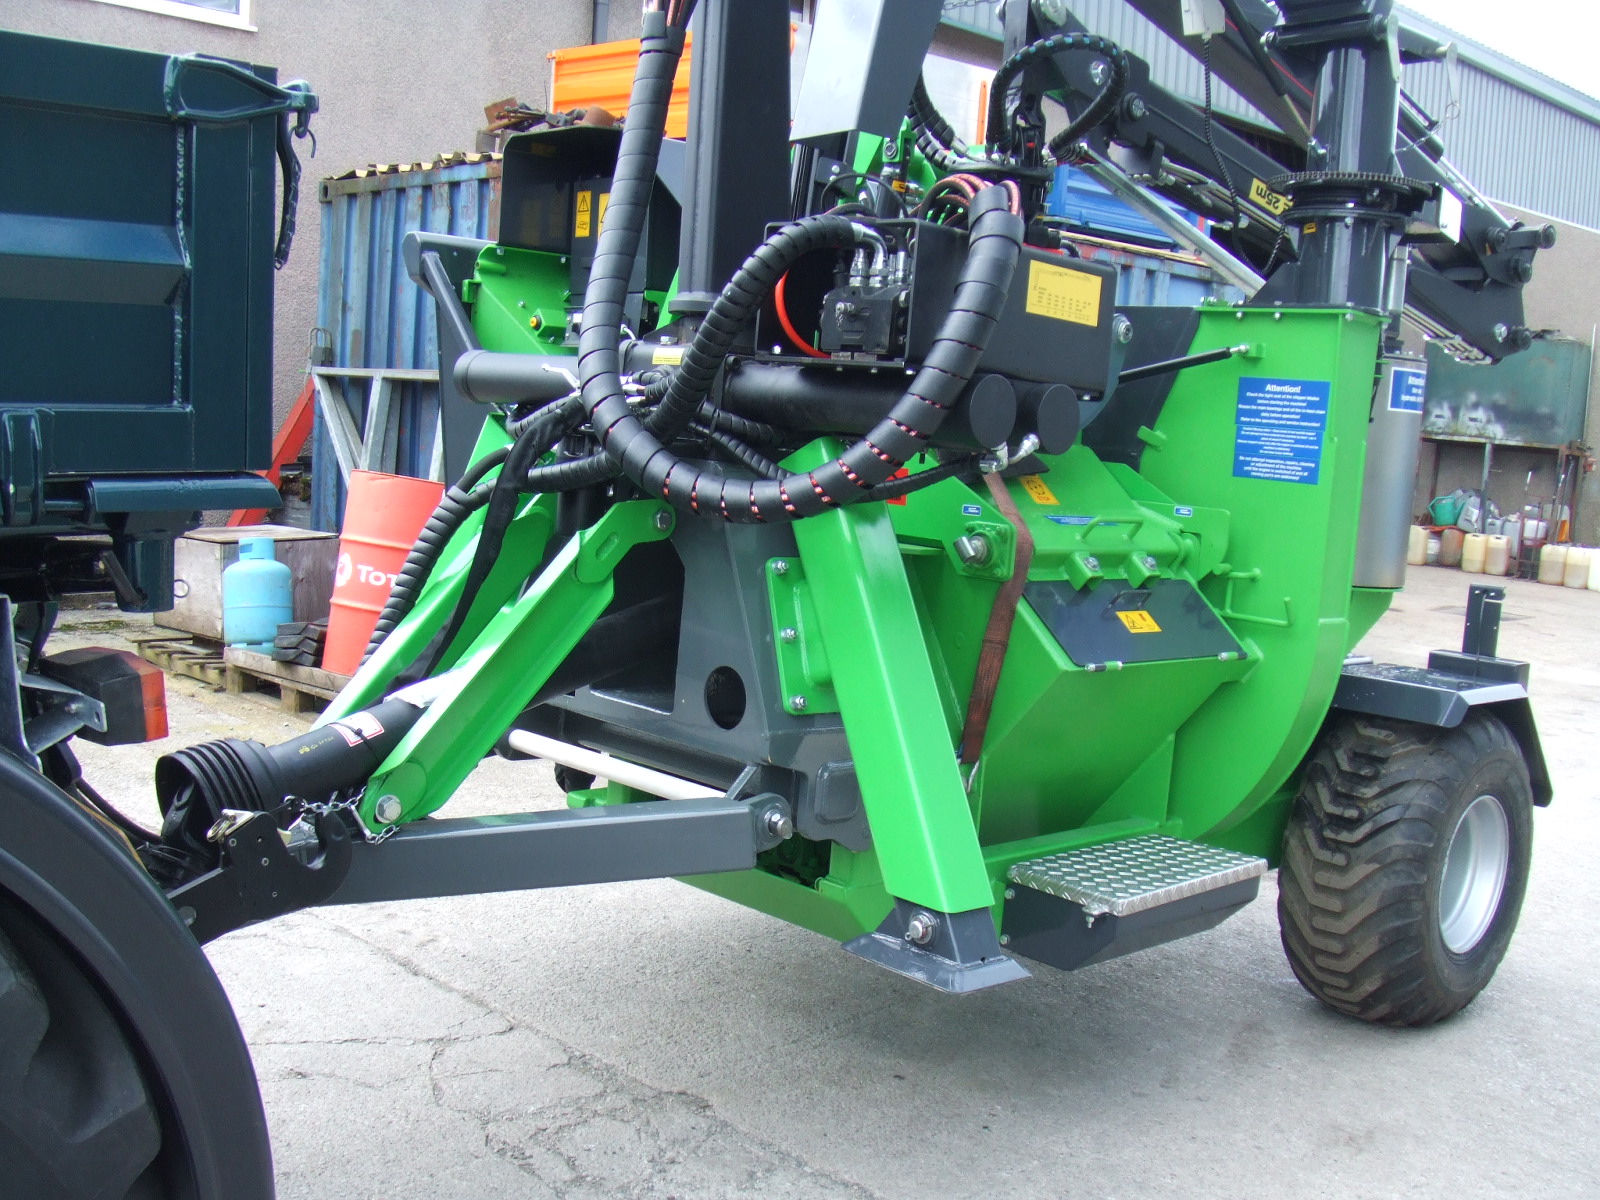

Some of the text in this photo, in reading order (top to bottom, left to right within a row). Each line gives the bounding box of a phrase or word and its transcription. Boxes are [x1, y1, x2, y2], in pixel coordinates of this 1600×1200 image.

[1256, 185, 1281, 209] 25m
[1266, 384, 1301, 393] Attention!
[357, 564, 398, 588] TOT
